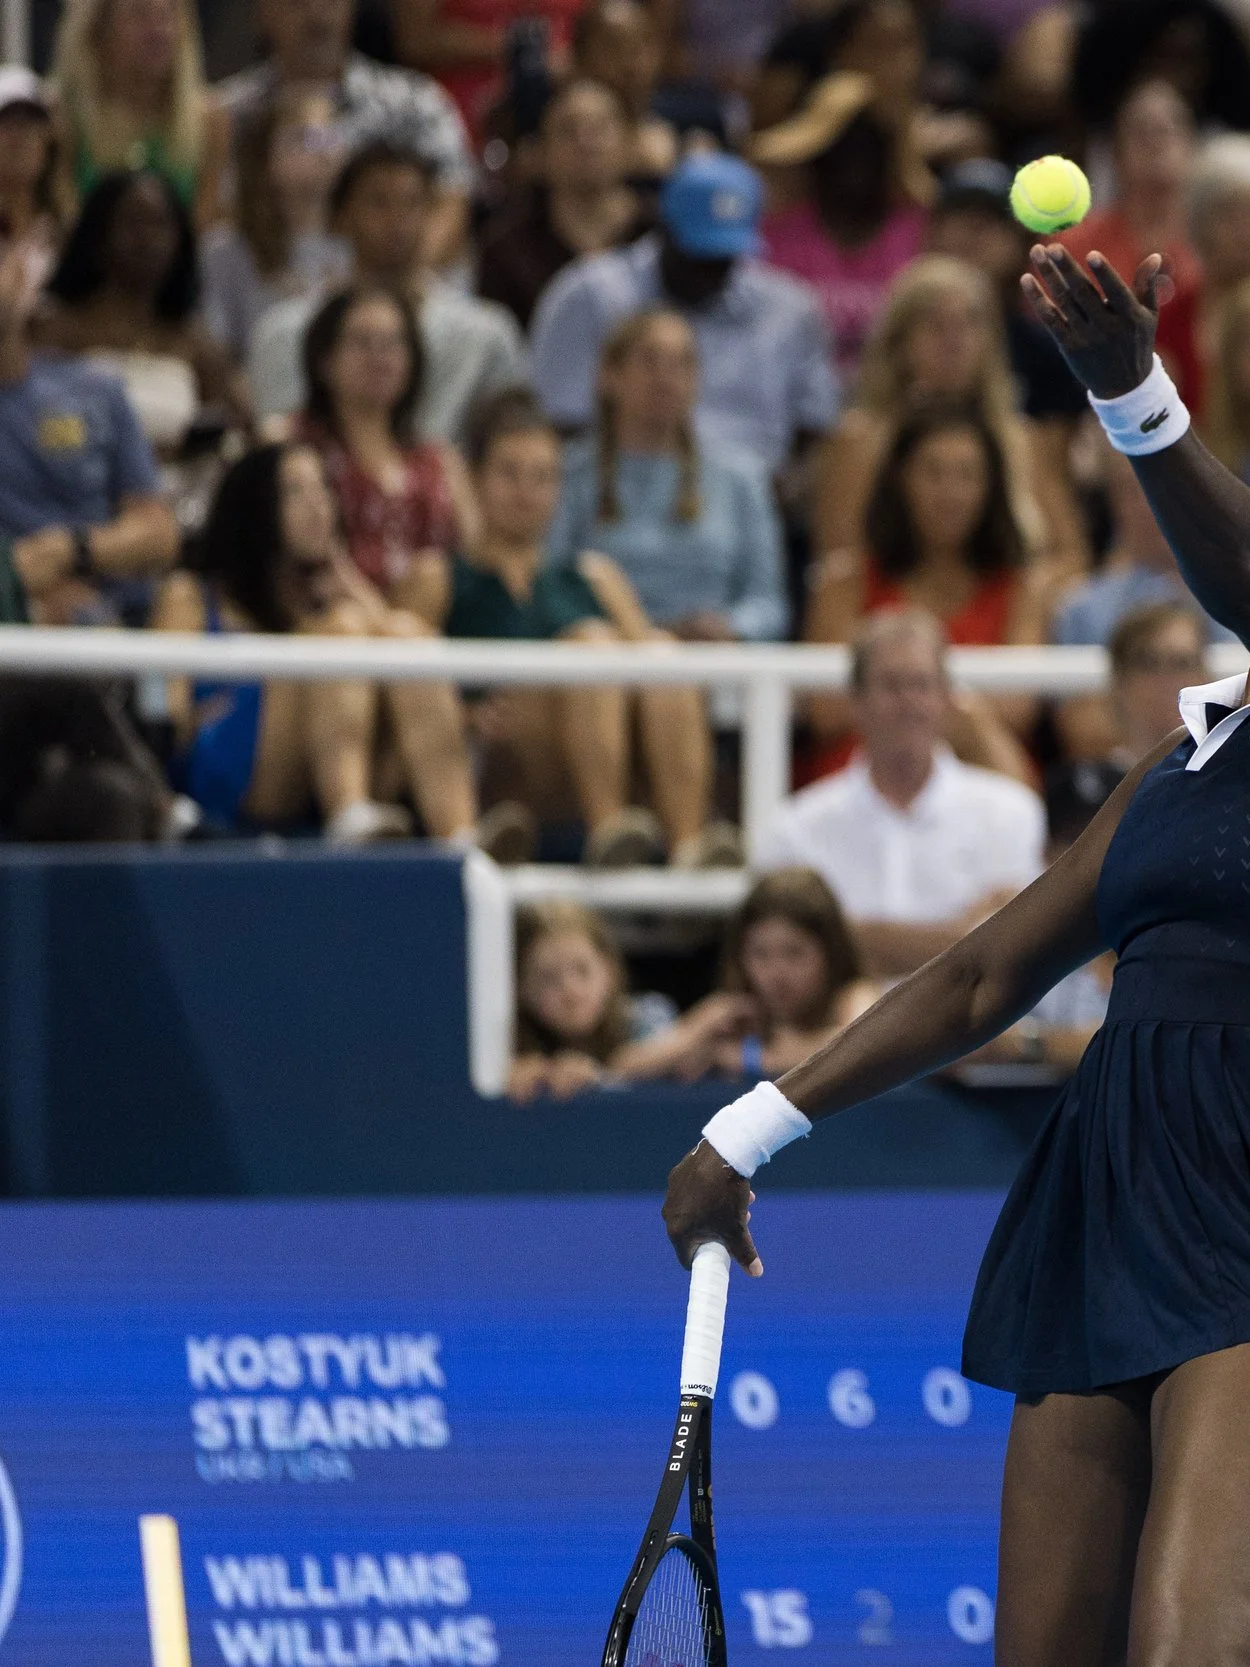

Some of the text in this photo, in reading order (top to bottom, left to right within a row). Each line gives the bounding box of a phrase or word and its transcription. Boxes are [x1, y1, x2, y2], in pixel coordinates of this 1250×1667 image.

[185, 1334, 446, 1390] KOSTYUK
[191, 1396, 450, 1450] STEARNS
[730, 1366, 972, 1430] 0 6 0
[669, 1413, 693, 1471] BLADE
[203, 1552, 471, 1609] WILLIAMS
[211, 1614, 500, 1667] WILLIAMS
[740, 1586, 995, 1648] 15 2 0
